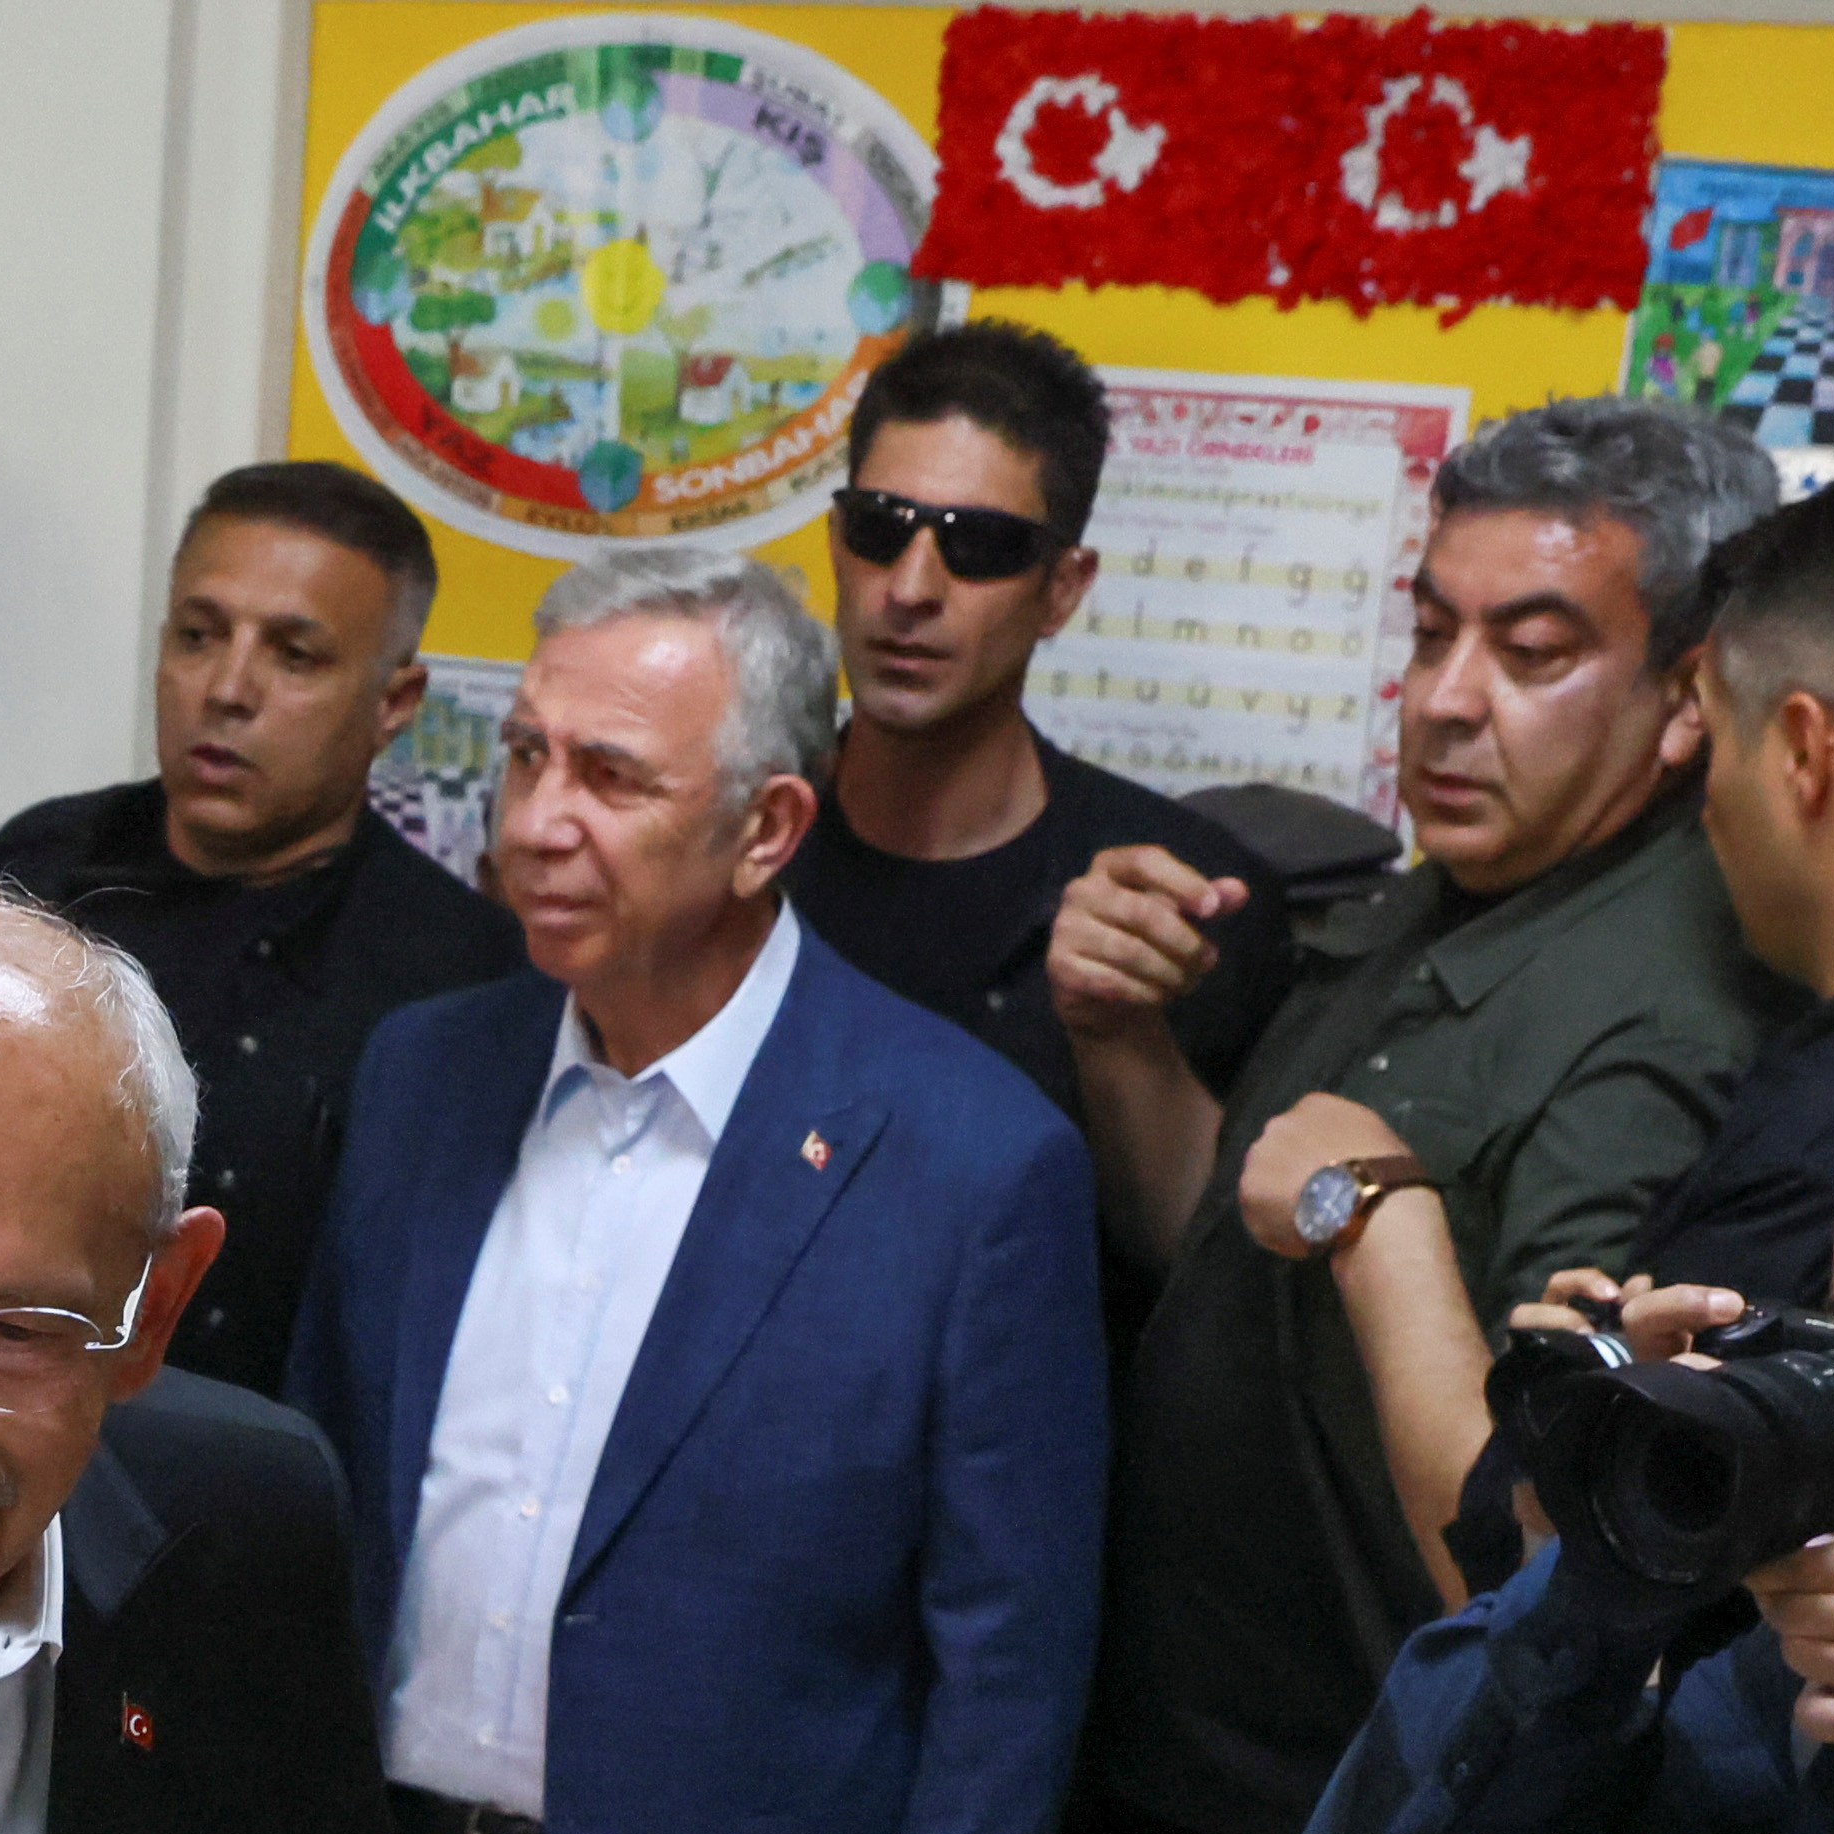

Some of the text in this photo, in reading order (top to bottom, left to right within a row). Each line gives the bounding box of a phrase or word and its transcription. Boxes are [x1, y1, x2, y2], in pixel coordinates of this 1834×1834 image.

[752, 104, 831, 170] KIŞ
[1184, 558, 1208, 581] e
[1173, 618, 1208, 642] m
[1235, 620, 1263, 646] n
